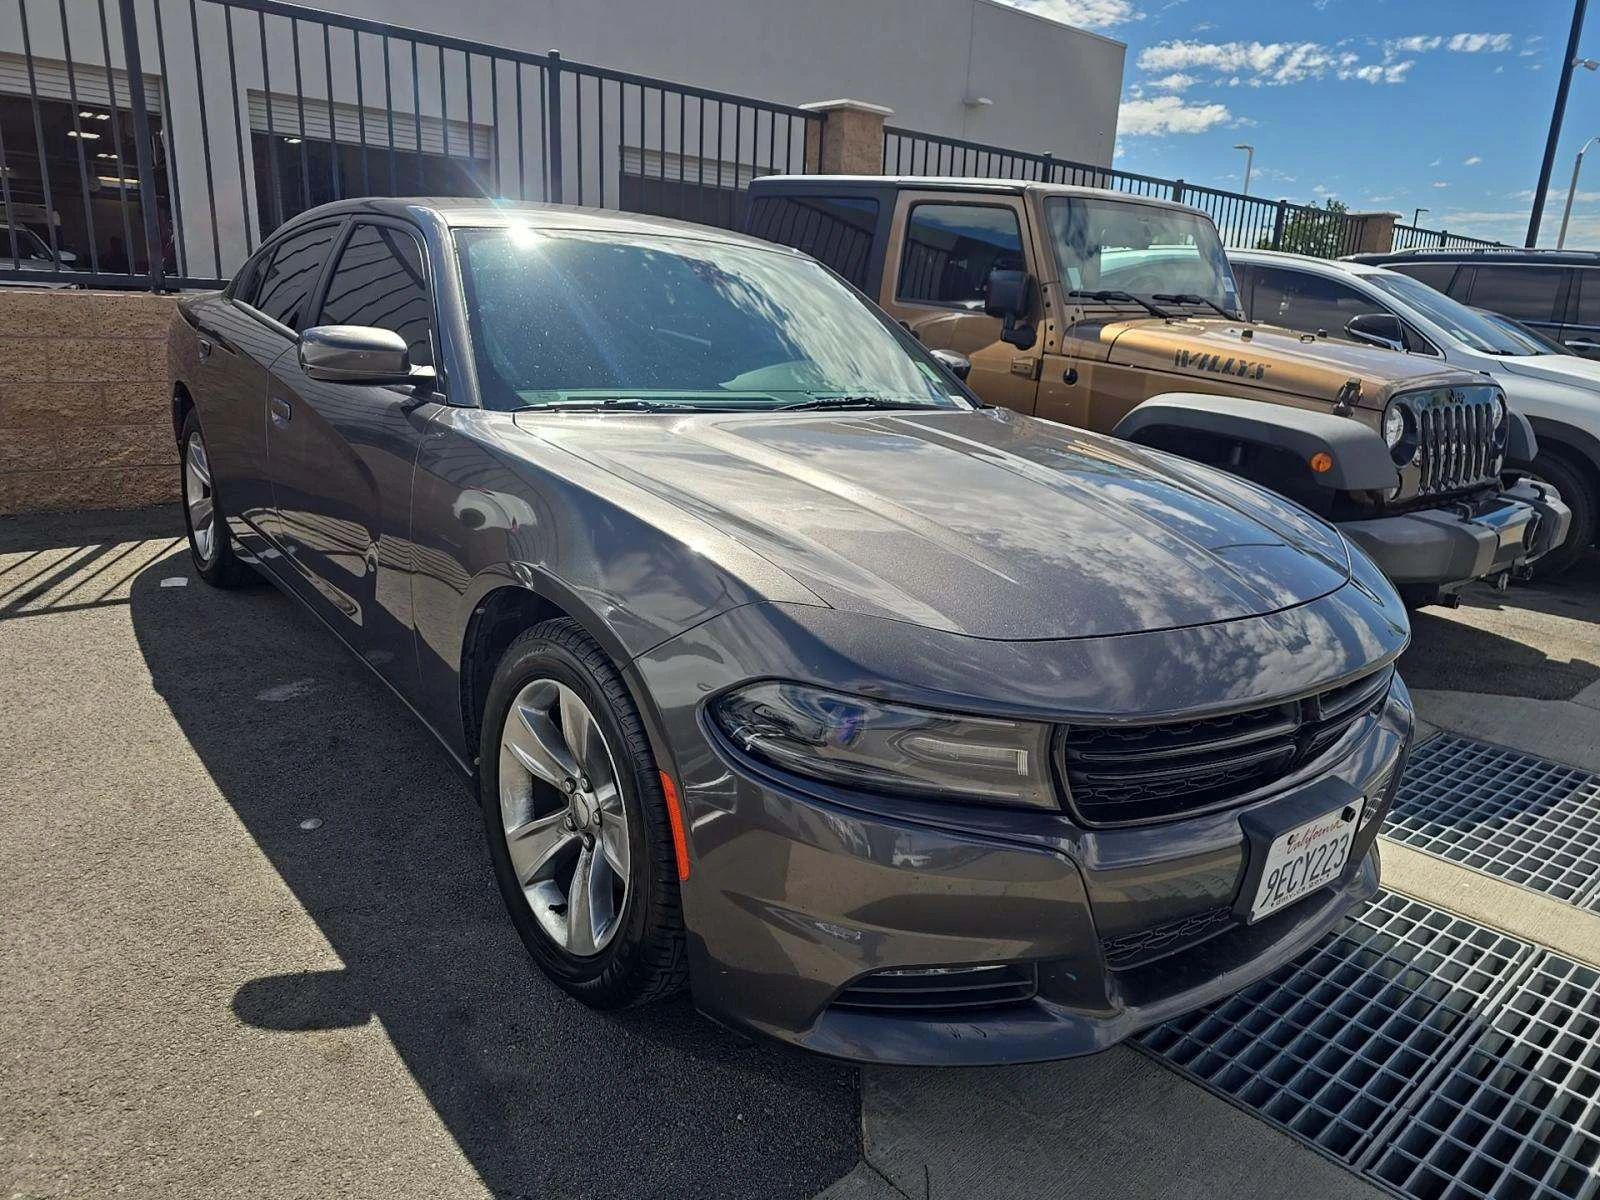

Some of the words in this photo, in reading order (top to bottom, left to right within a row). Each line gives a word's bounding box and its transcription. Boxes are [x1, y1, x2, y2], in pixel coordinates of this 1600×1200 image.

[1173, 348, 1271, 380] WILLYS
[1287, 819, 1343, 855] California
[1260, 832, 1350, 909] 9ECY223
